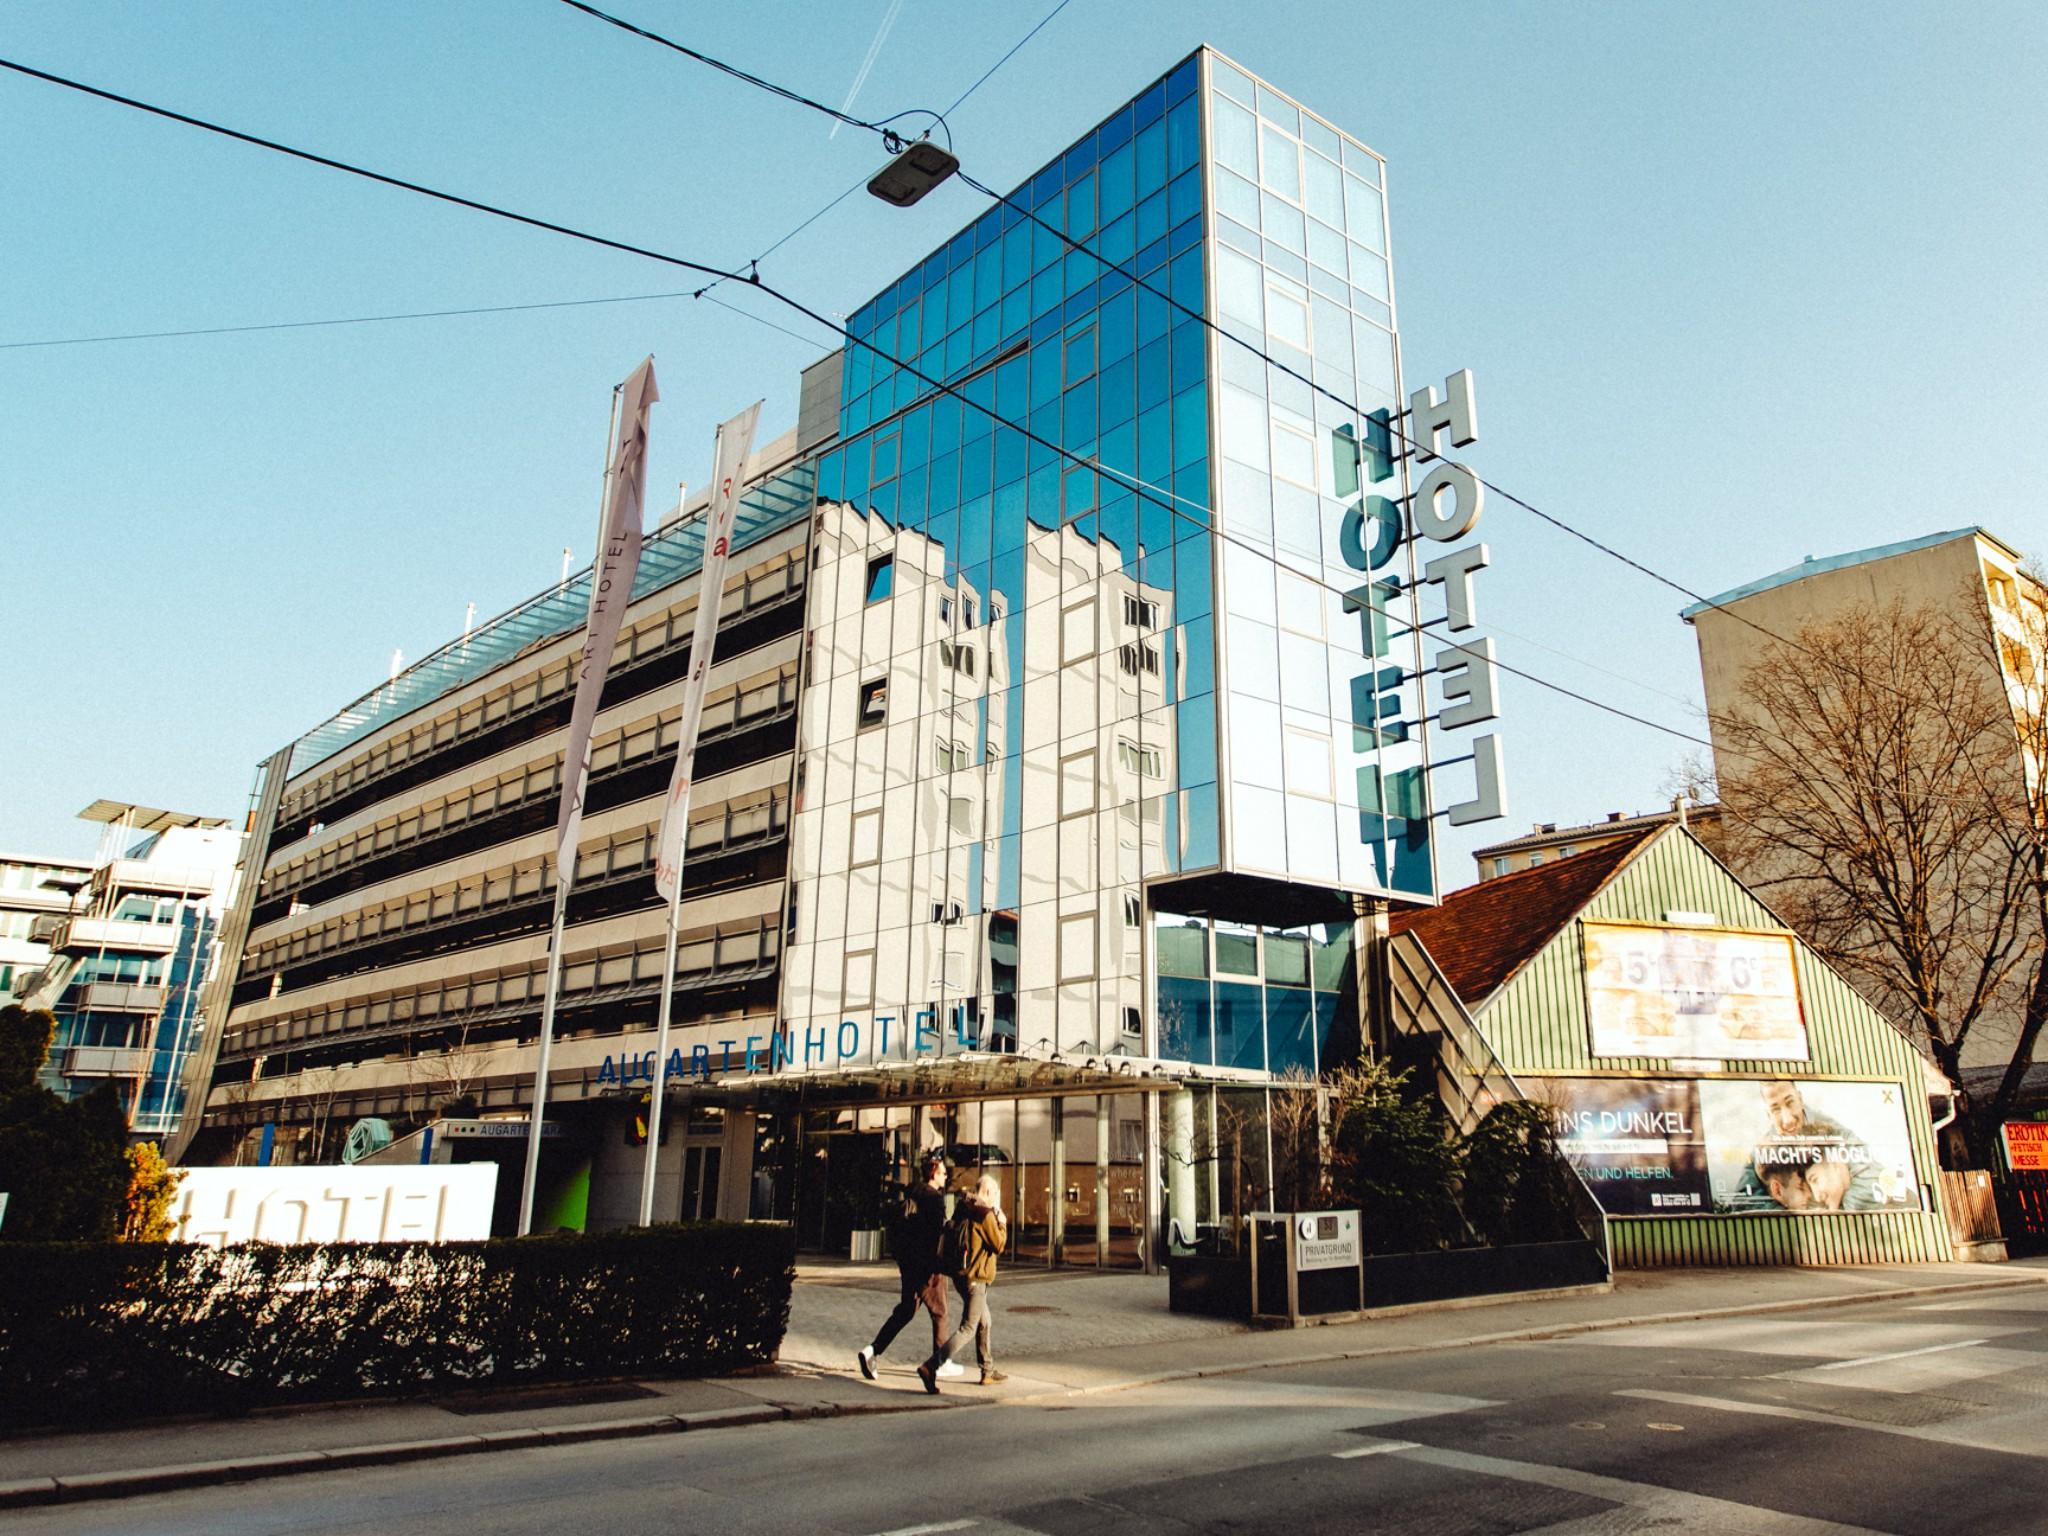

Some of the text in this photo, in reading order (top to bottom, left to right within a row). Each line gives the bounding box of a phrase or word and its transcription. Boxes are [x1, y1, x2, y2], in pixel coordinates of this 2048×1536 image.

[594, 532, 628, 614] HOTEL
[596, 1003, 978, 1085] AUGARTENHOTEL
[1601, 1112, 1693, 1134] DUNKEL
[1755, 1146, 1823, 1165] MACHT'S
[2013, 1155, 2040, 1166] MESSE
[1596, 1167, 1622, 1180] UND
[1305, 1242, 1352, 1256] PRIVATGRUND
